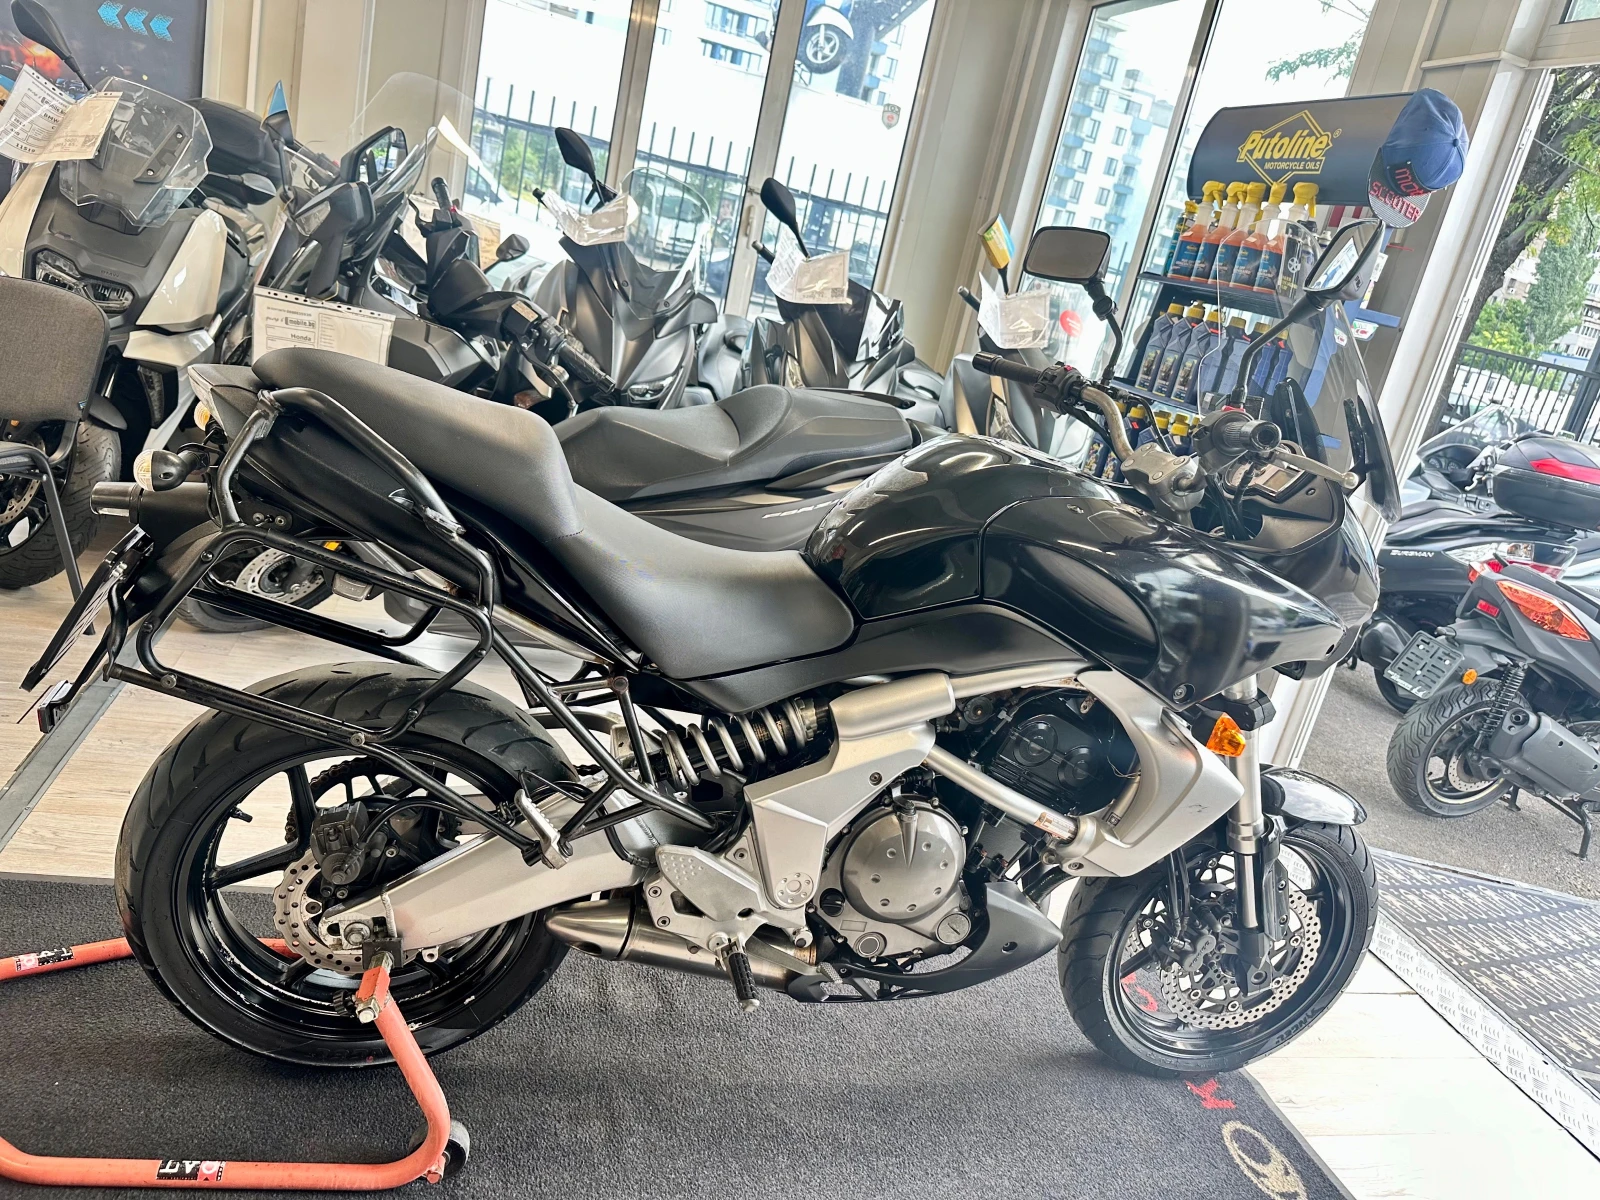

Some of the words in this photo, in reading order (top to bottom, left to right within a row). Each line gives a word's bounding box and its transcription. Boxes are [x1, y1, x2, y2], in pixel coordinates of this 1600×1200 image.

[1239, 129, 1328, 160] Putoline
[1263, 161, 1305, 170] MOTORCYCLE
[1305, 161, 1321, 170] OILS
[1369, 181, 1422, 222] SCOOTER
[290, 333, 312, 342] Honda
